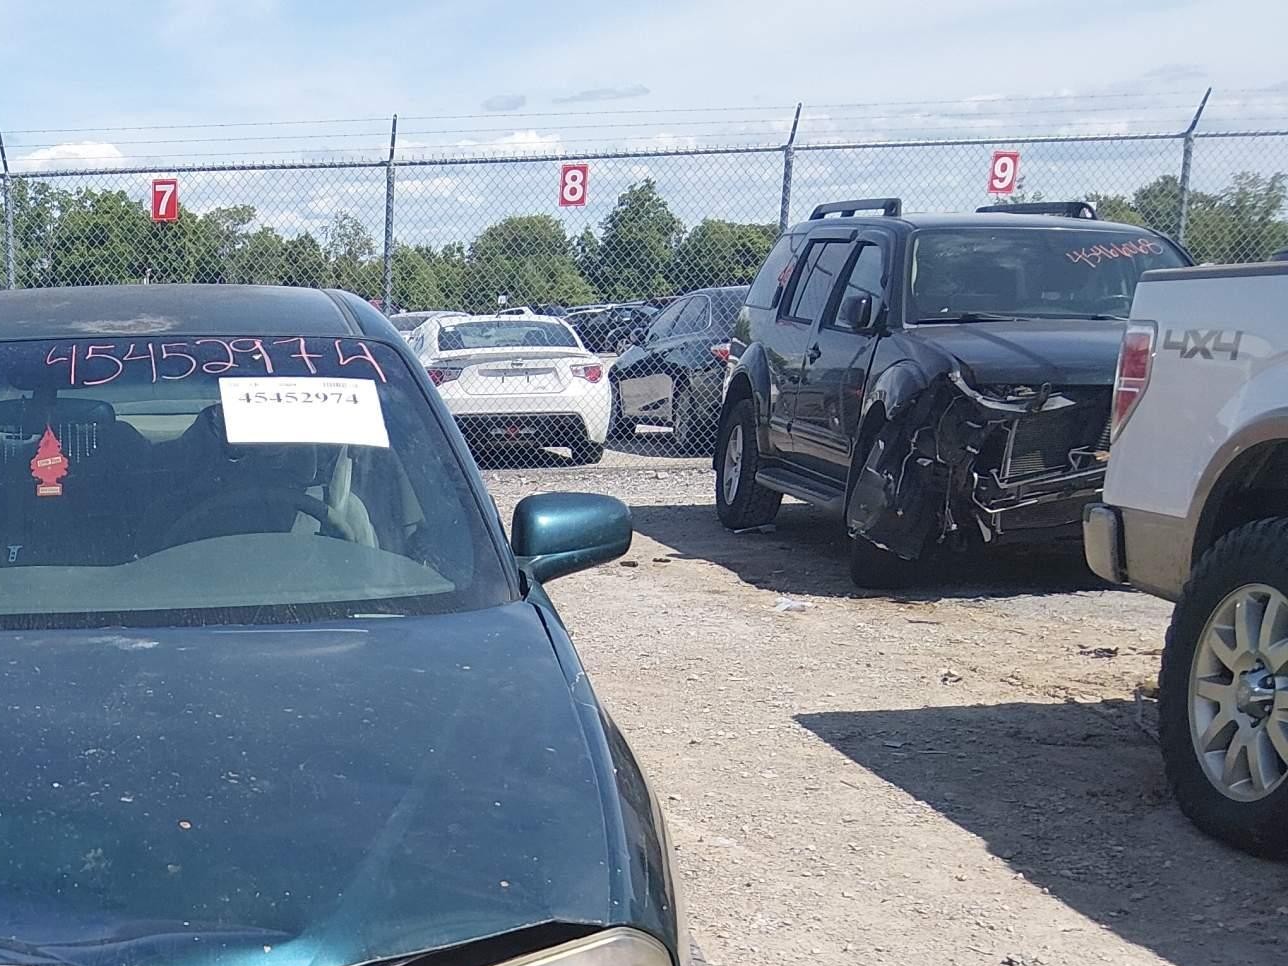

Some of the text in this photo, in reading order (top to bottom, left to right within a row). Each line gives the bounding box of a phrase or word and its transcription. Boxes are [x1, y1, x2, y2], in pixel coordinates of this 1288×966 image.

[563, 169, 584, 202] 8
[993, 157, 1015, 189] 9
[154, 183, 175, 216] 7
[46, 338, 387, 385] 45452974
[239, 391, 360, 405] 45452974
